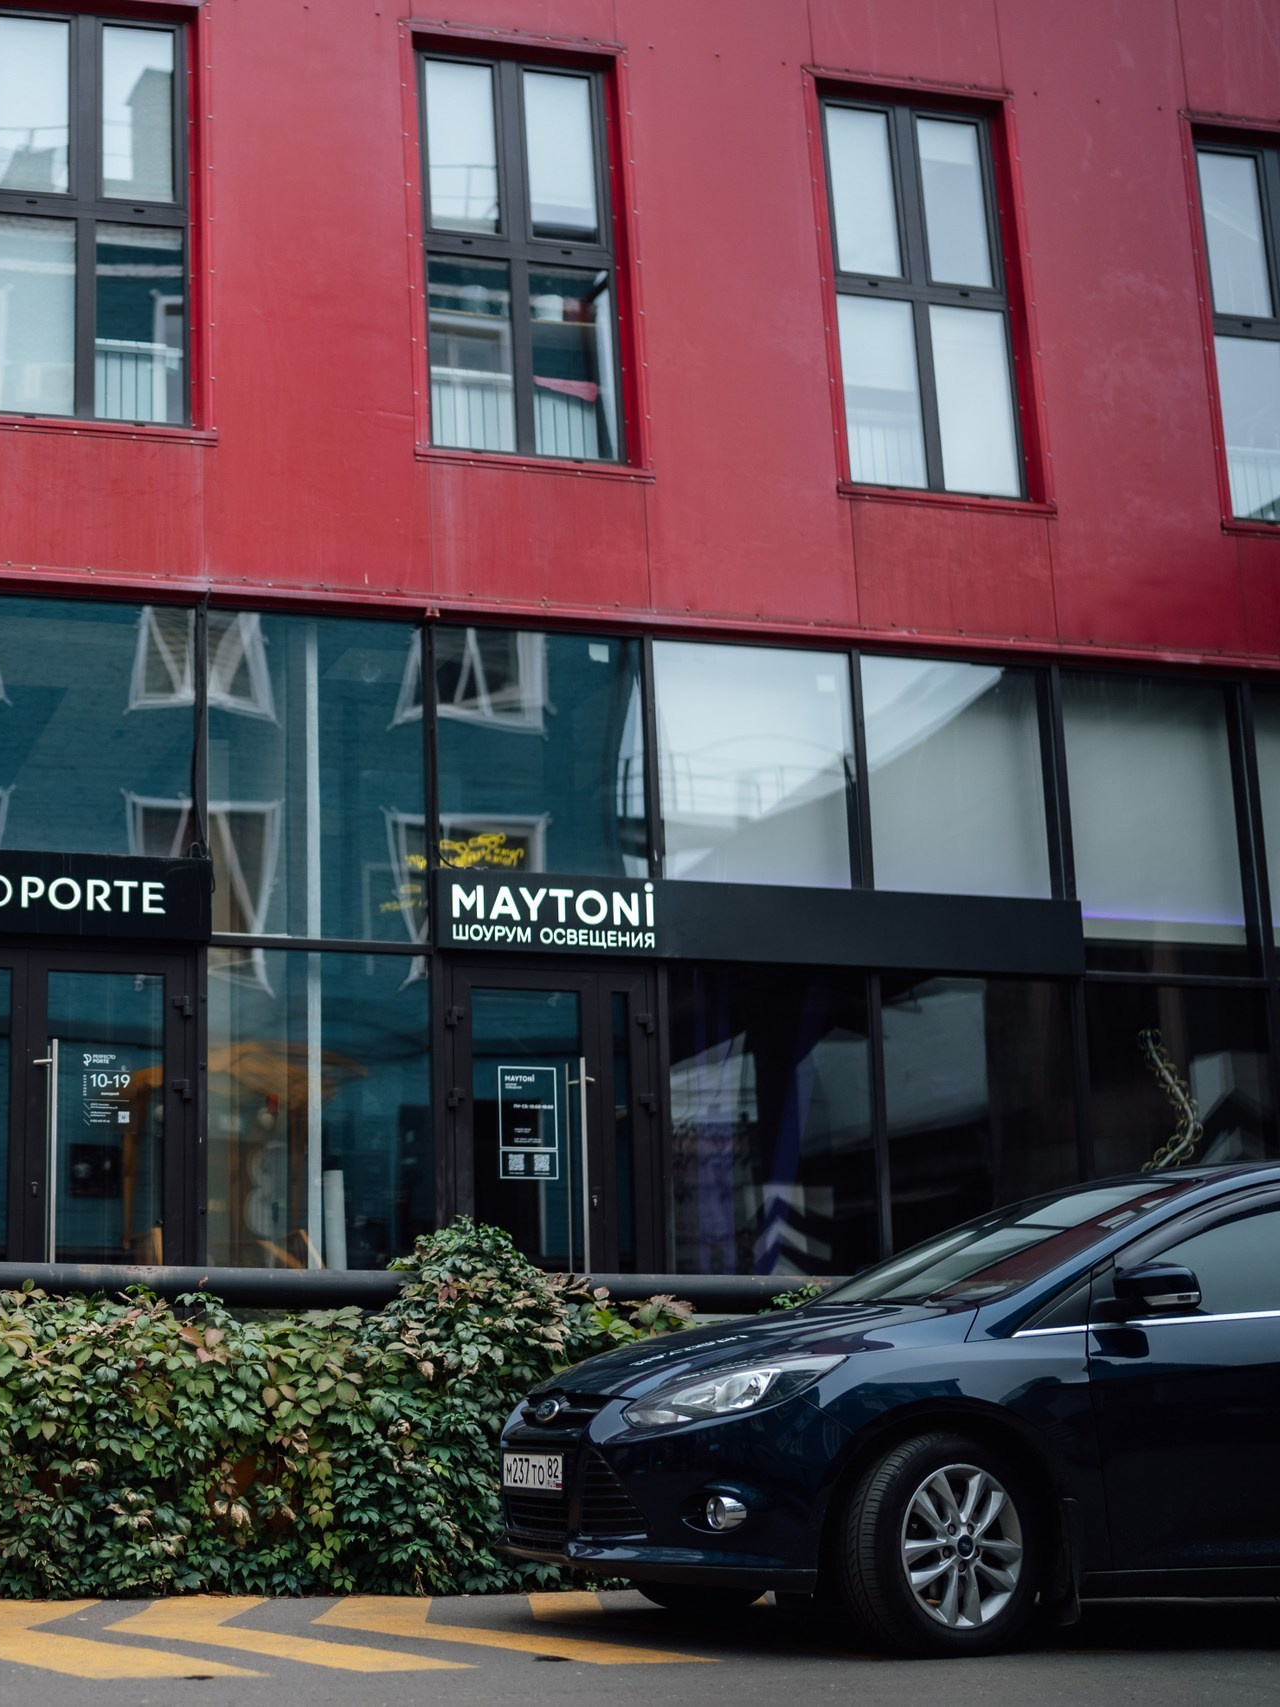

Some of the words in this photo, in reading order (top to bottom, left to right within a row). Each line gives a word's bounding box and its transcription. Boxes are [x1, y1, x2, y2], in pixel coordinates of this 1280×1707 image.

[452, 923, 532, 944] ШОУРУМ
[539, 927, 656, 949] ОСВЕЩЕНИЯ
[90, 1073, 131, 1089] 10-19
